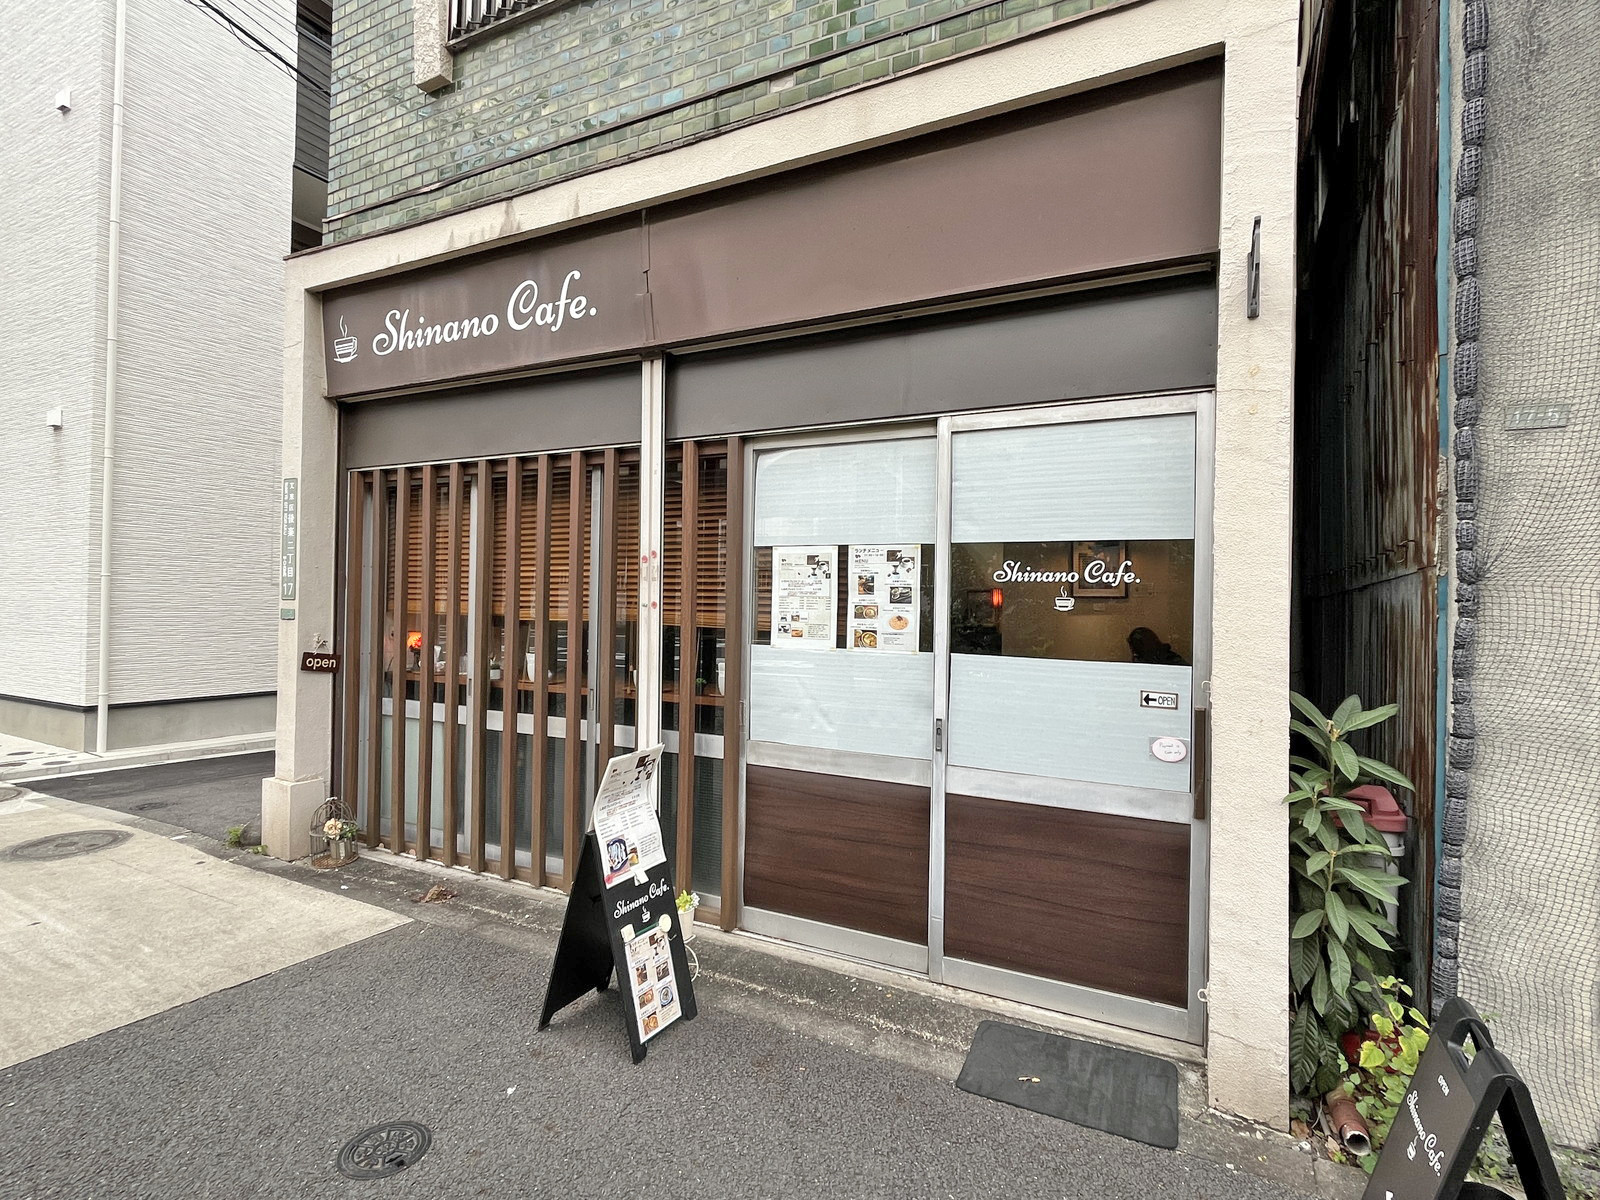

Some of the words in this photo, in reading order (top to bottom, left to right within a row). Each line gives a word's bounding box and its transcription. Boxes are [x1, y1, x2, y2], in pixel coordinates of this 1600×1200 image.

[372, 308, 499, 356] Shinano
[506, 269, 597, 332] Cafe.
[993, 560, 1079, 582] Shinano
[1084, 560, 1141, 586] Cafe.
[282, 582, 294, 596] 17
[306, 657, 336, 670] open
[1157, 695, 1176, 706] OPEN
[614, 894, 649, 918] Shinano
[649, 878, 670, 898] Cafe.
[1438, 1075, 1450, 1096] OPEN
[1407, 1090, 1426, 1141] Shinano
[1424, 1133, 1445, 1177] Cafe.
